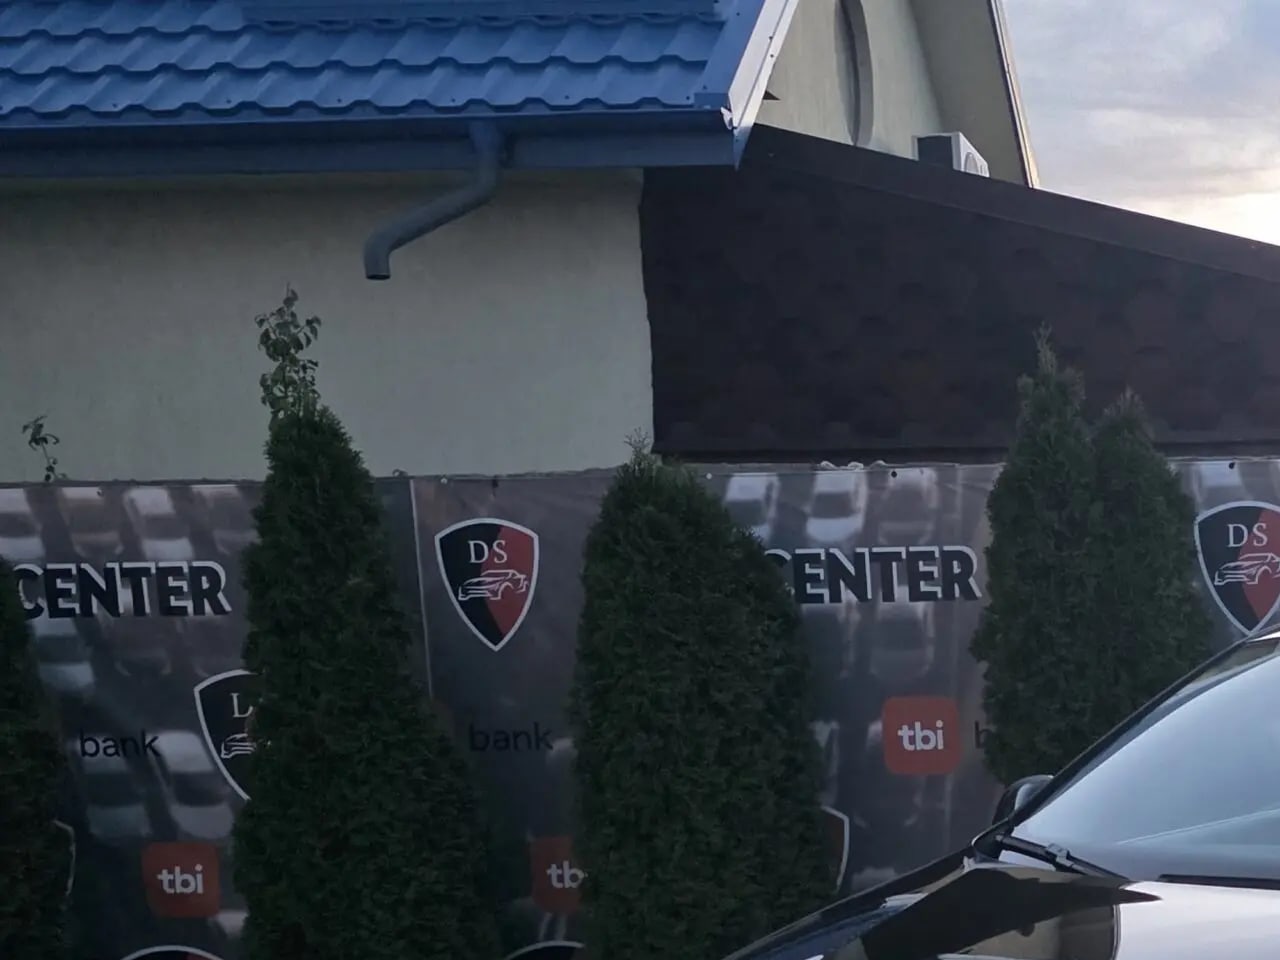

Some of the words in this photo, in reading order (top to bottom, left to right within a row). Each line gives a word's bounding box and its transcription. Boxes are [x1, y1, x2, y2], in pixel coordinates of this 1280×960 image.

[1226, 522, 1268, 548] DS
[468, 540, 508, 563] DS
[14, 560, 232, 618] CENTER
[79, 727, 160, 758] bank
[469, 721, 554, 752] bank
[897, 720, 944, 751] tbi
[157, 864, 205, 895] tbi
[546, 860, 585, 889] tb
